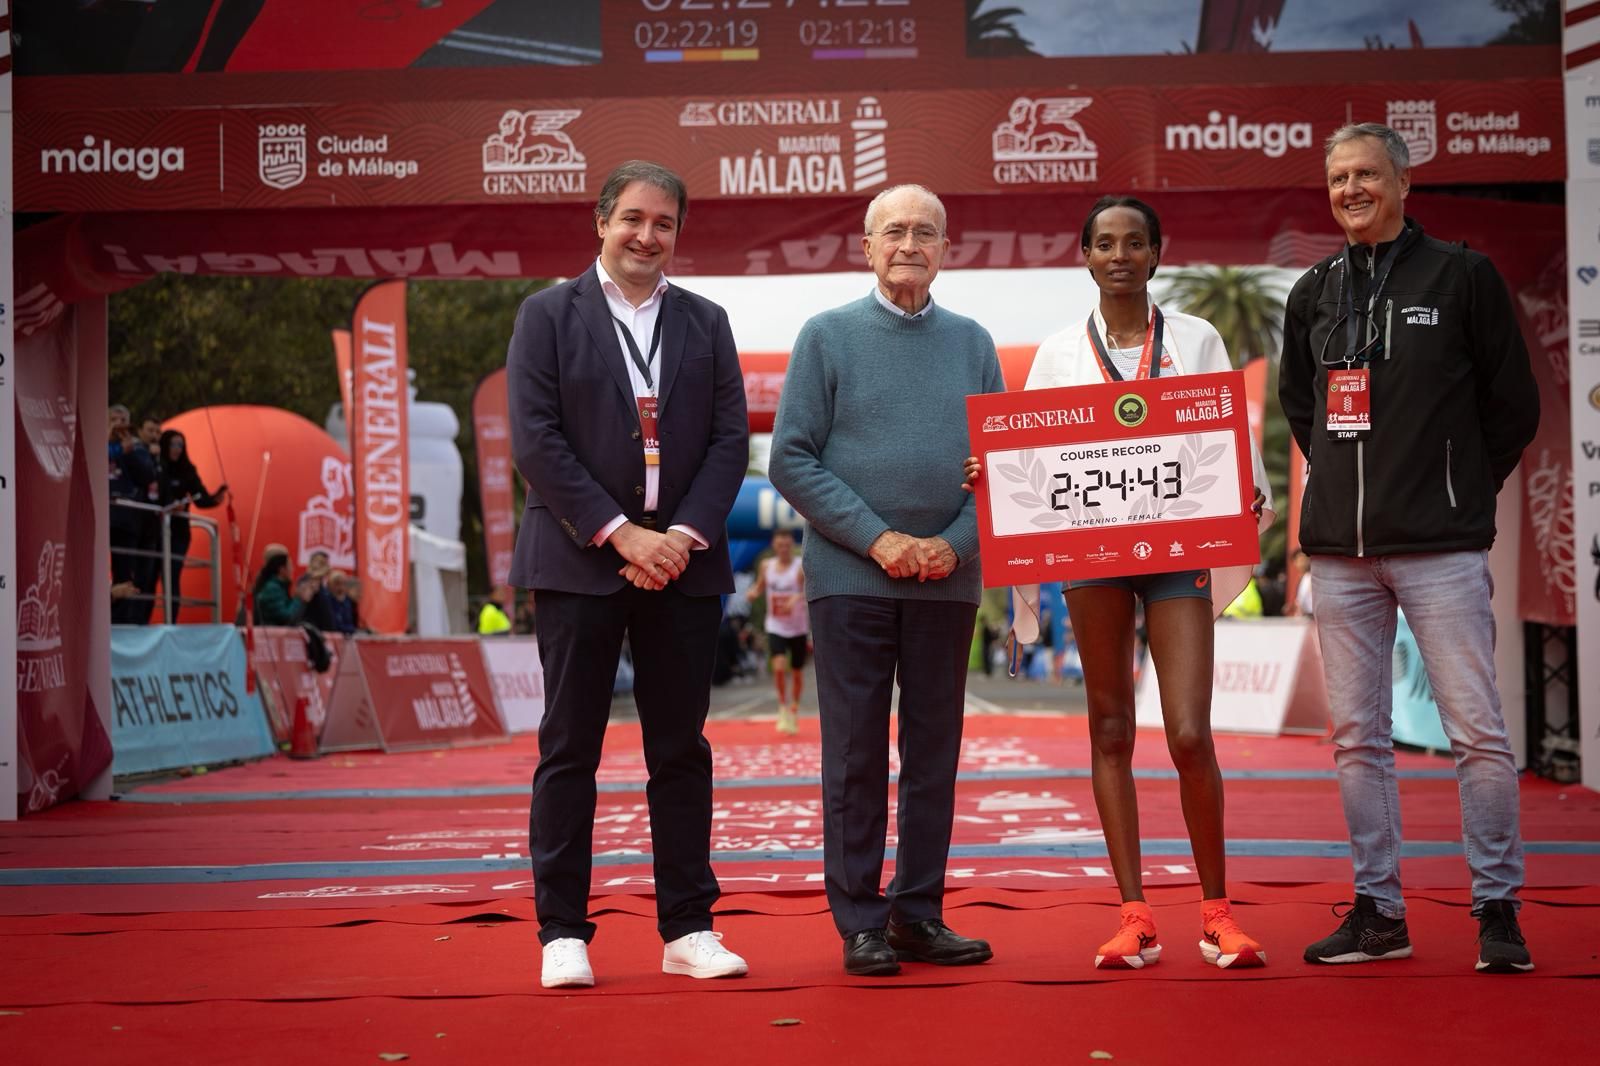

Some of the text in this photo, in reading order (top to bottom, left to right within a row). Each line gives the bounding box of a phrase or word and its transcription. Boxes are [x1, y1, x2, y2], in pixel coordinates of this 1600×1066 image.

[634, 20, 759, 49] 02:22:19
[799, 18, 918, 46] 02:12:18
[717, 100, 841, 126] GENERALI
[1447, 112, 1520, 131] Ciudad
[318, 134, 388, 155] Ciudad
[778, 134, 841, 155] MARATÓN
[1447, 134, 1551, 157] de Málaga
[318, 157, 419, 180] de Málaga
[719, 150, 847, 196] MÁLAGA
[993, 162, 1098, 184] GENERALI
[483, 172, 588, 195] GENERALI
[1173, 387, 1216, 400] GENERALI
[362, 316, 403, 526] GENERALI
[1008, 406, 1096, 431] GENERALI
[1175, 404, 1220, 424] MÁLAGA
[1060, 444, 1161, 462] COURSE RECORD
[1051, 461, 1182, 511] 2:24:43
[1071, 516, 1118, 527] FEMENINO
[1127, 512, 1163, 522] FEMALE
[111, 670, 239, 728] ATHLETICS
